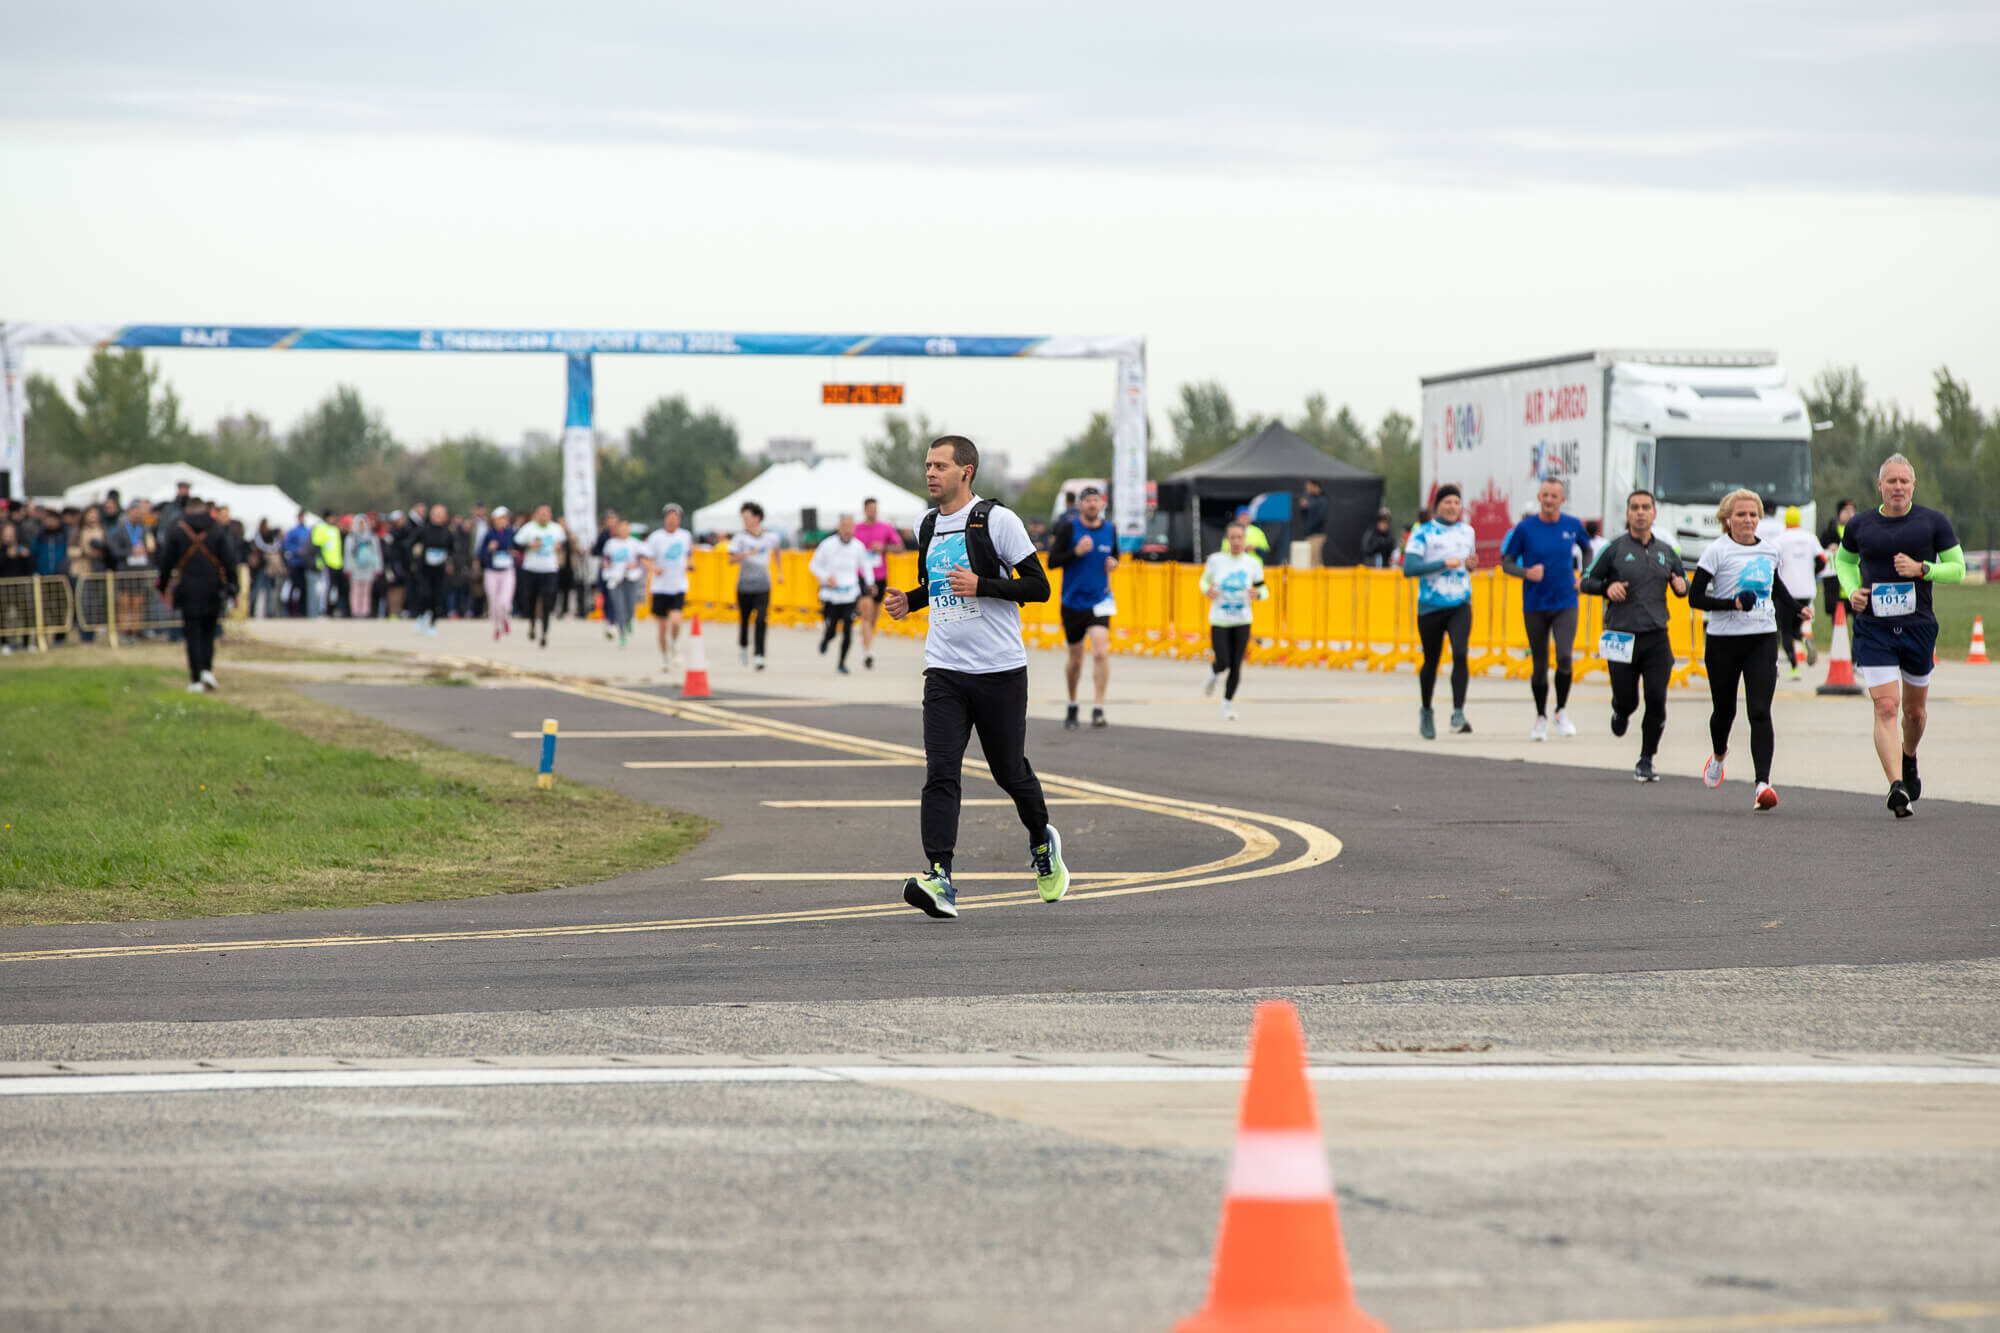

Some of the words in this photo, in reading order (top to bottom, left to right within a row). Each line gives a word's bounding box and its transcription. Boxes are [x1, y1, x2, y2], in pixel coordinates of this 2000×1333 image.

[181, 327, 231, 346] RAJT
[551, 331, 635, 351] AIRPORT
[639, 332, 683, 351] RUN
[1524, 388, 1545, 426] AIR
[1548, 383, 1588, 423] CARGO
[934, 594, 966, 608] 1381
[1879, 594, 1908, 605] 1012
